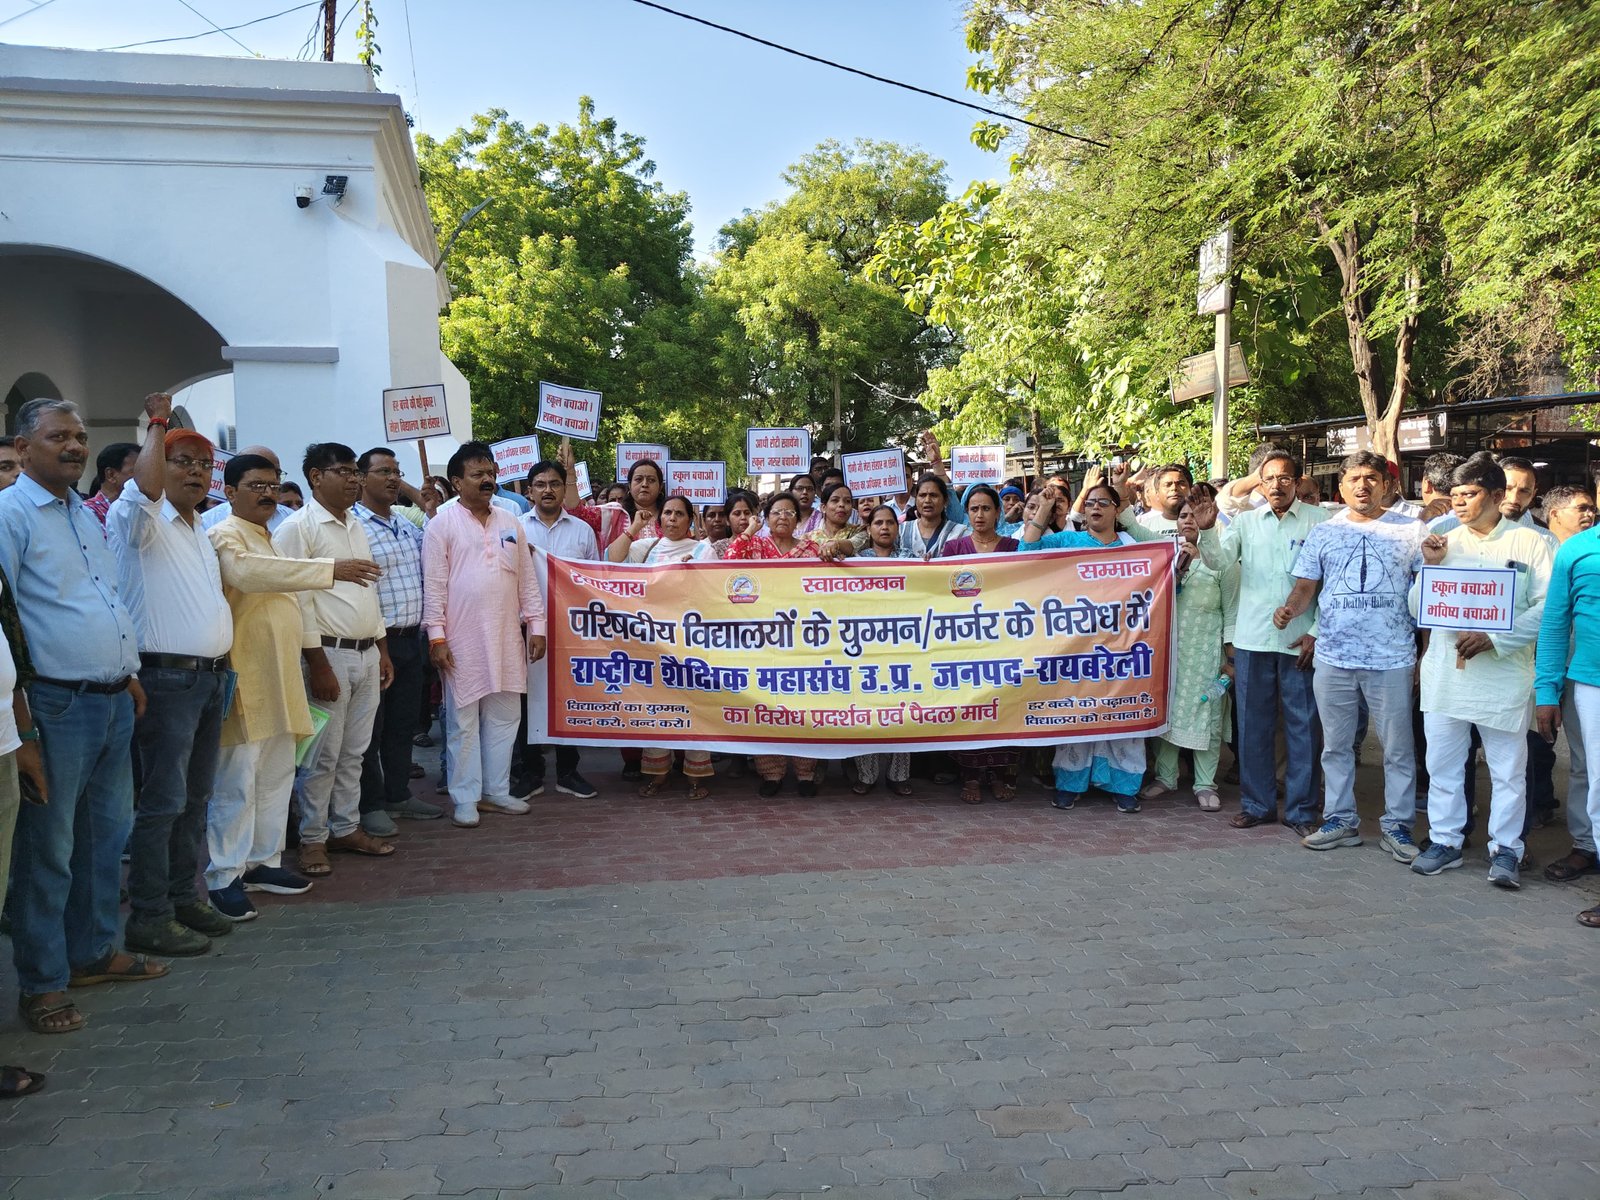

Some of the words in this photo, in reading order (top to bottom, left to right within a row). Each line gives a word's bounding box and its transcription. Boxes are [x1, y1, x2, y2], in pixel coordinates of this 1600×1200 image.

[546, 394, 562, 408] स्कूल
[543, 412, 562, 426] समाज
[752, 457, 764, 470] स्कूल
[673, 471, 690, 482] स्कूल
[1078, 561, 1149, 580] सम्मान
[802, 577, 906, 592] स्वावलम्बन
[1432, 581, 1457, 597] स्कूल
[1371, 596, 1394, 608] Hallows
[1428, 602, 1459, 619] भविष्य
[569, 601, 676, 643] परिषदीय
[683, 611, 797, 650] विद्यालयों
[802, 612, 831, 646] के
[1004, 602, 1034, 638] के
[1042, 598, 1120, 636] विरोध
[1126, 591, 1153, 629] में
[571, 651, 654, 693] राष्ट्रीय
[661, 656, 748, 692] शैक्षिक
[757, 660, 852, 693] महासंघ
[567, 701, 622, 712] विद्यालयों
[624, 704, 642, 712] का
[1028, 702, 1045, 711] हर
[1078, 698, 1098, 708] को
[1101, 697, 1136, 708] पढ़ाना
[723, 707, 749, 725] का
[754, 704, 806, 727] विरोध
[810, 704, 872, 729] प्रदर्शन
[877, 702, 906, 727] एवं
[909, 703, 955, 726] पैदल
[960, 699, 999, 721] मार्च
[1025, 715, 1076, 725] विद्यालय
[1080, 713, 1099, 723] को
[1102, 712, 1140, 722] बचाना
[567, 717, 593, 726] बन्द
[630, 718, 656, 727] बन्द
